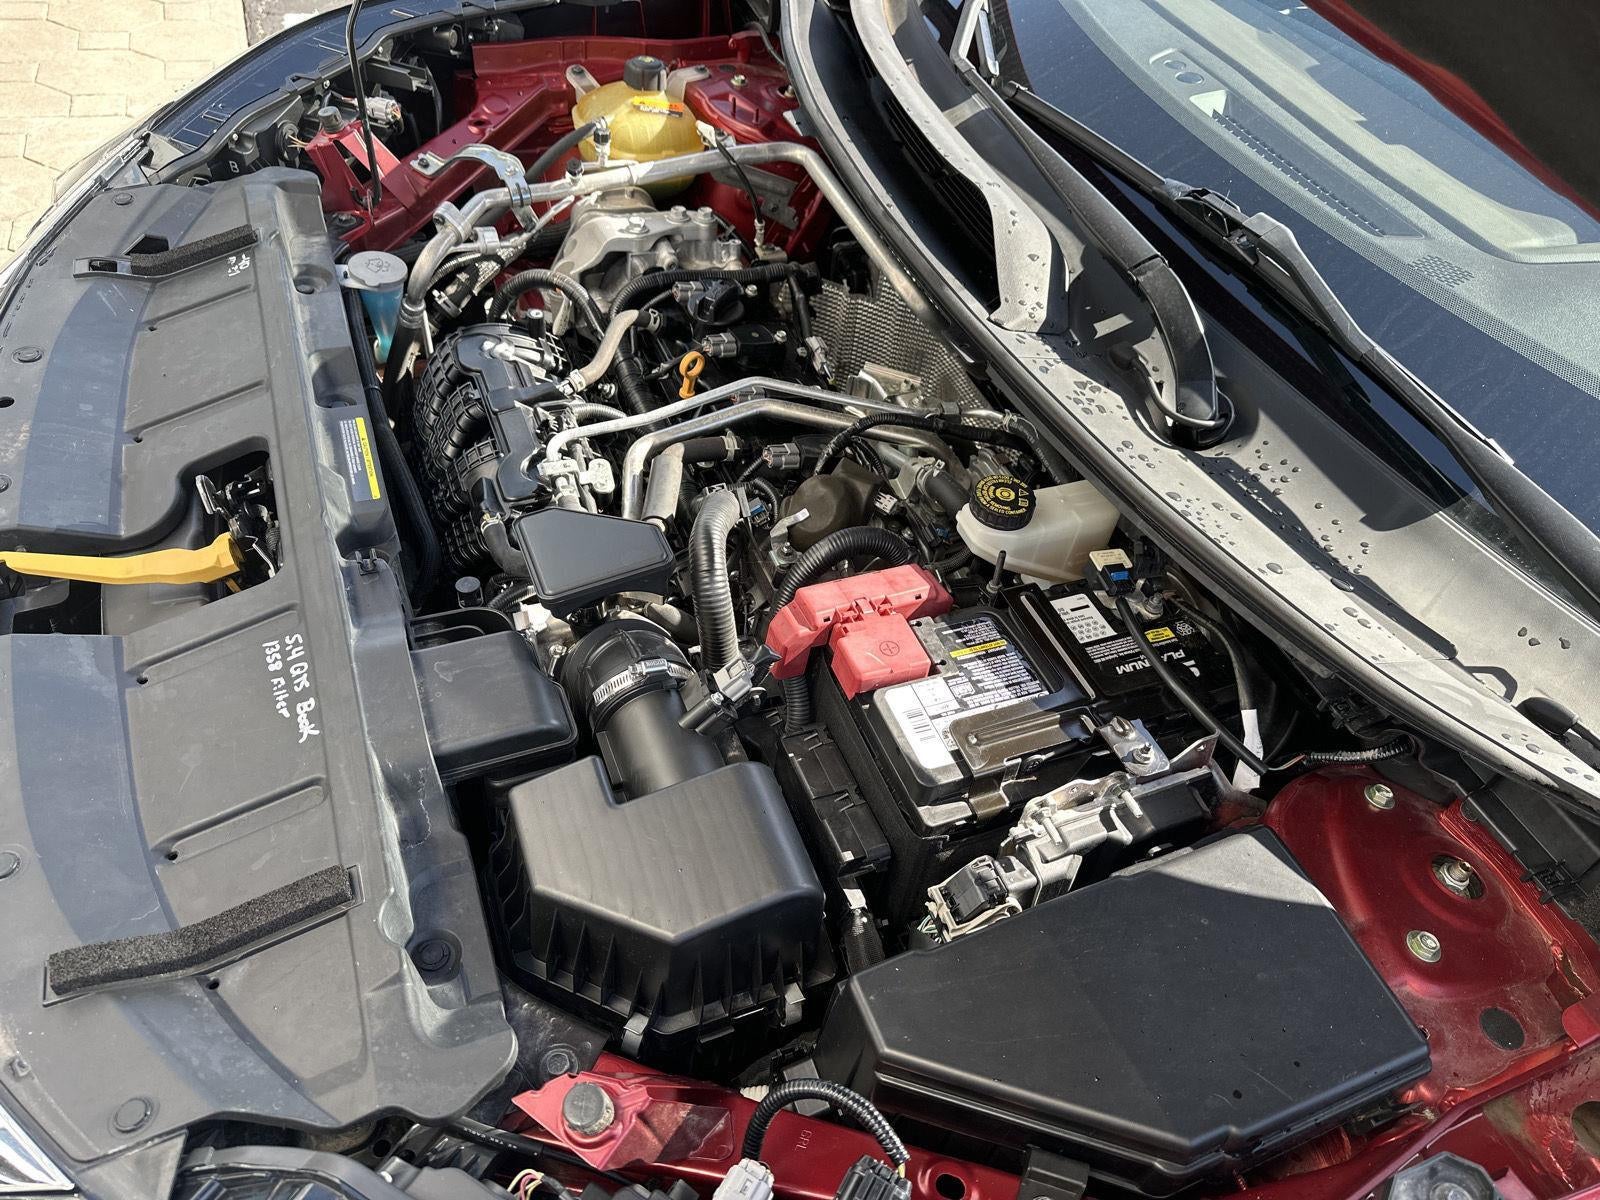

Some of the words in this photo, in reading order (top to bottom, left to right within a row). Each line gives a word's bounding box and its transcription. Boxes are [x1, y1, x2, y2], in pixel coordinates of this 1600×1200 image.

[229, 161, 240, 173] B
[262, 640, 283, 671] 1358
[1115, 649, 1186, 675] PLANUM
